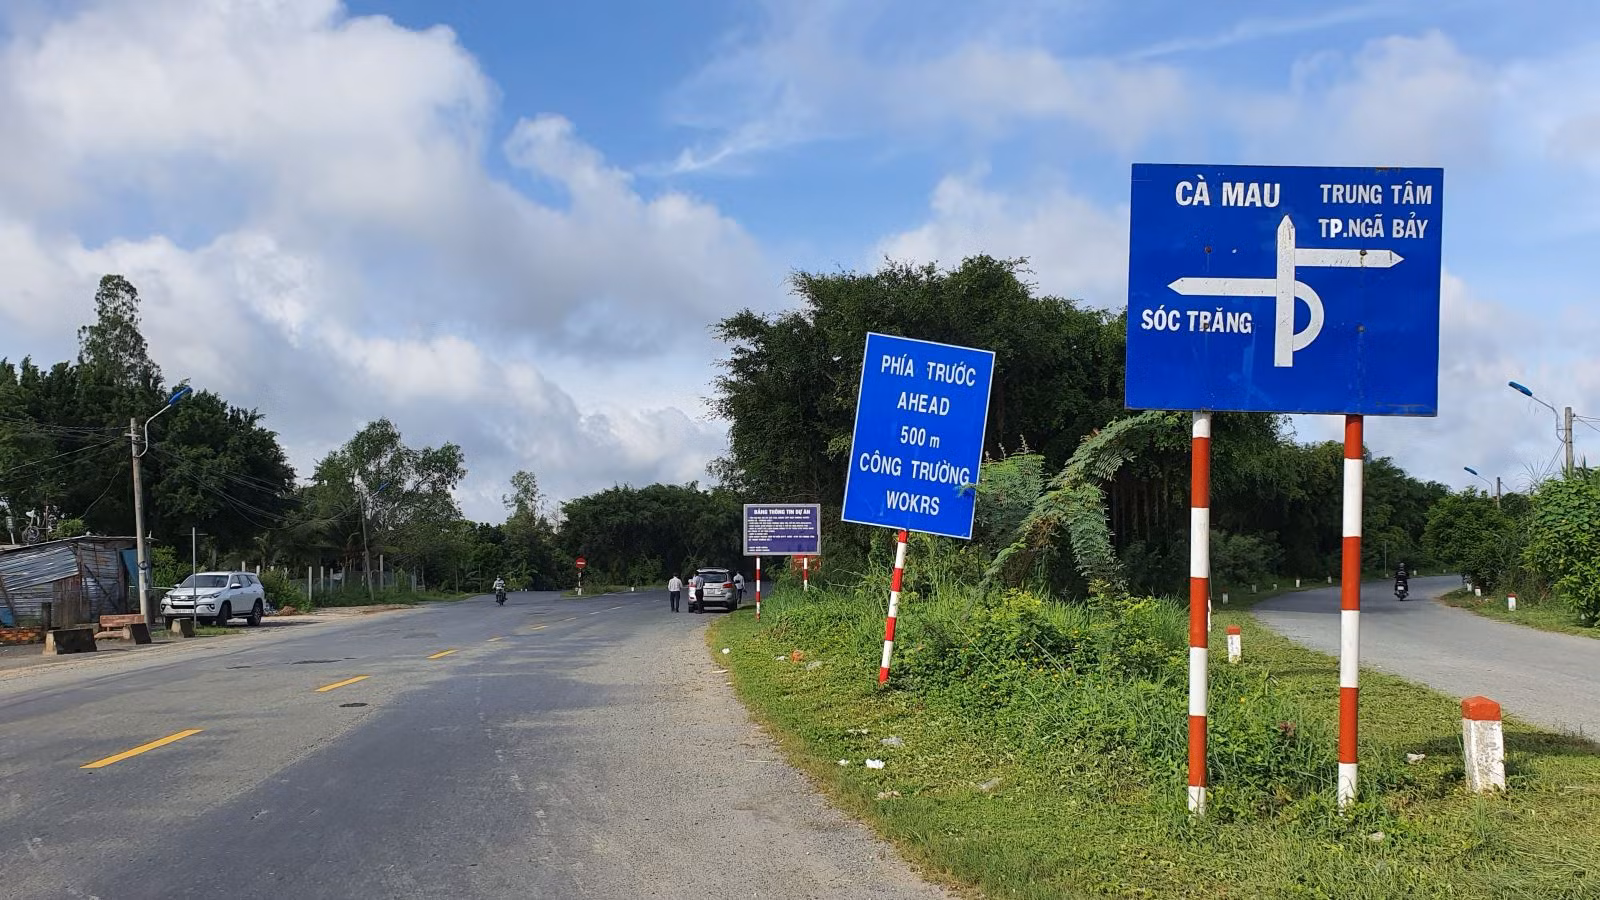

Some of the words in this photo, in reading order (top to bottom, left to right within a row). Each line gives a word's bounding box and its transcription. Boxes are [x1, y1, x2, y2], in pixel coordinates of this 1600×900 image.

[1175, 174, 1210, 206] CÀ
[1222, 182, 1281, 208] MAU
[1320, 183, 1383, 205] TRUNG
[1391, 180, 1433, 205] TÂM
[1318, 213, 1384, 239] TP.NGÃ
[1392, 211, 1429, 239] BẢY
[1141, 304, 1181, 332] SÓC
[1186, 307, 1252, 334] TRĂNG
[881, 353, 914, 378] PHÍA
[927, 360, 976, 387] TRƯỚC
[896, 391, 950, 416] AHEAD
[900, 426, 926, 447] 500
[929, 436, 940, 449] m
[859, 449, 902, 477] CÔNG
[911, 459, 970, 486] TRƯỜNG
[886, 490, 940, 516] WOKRS
